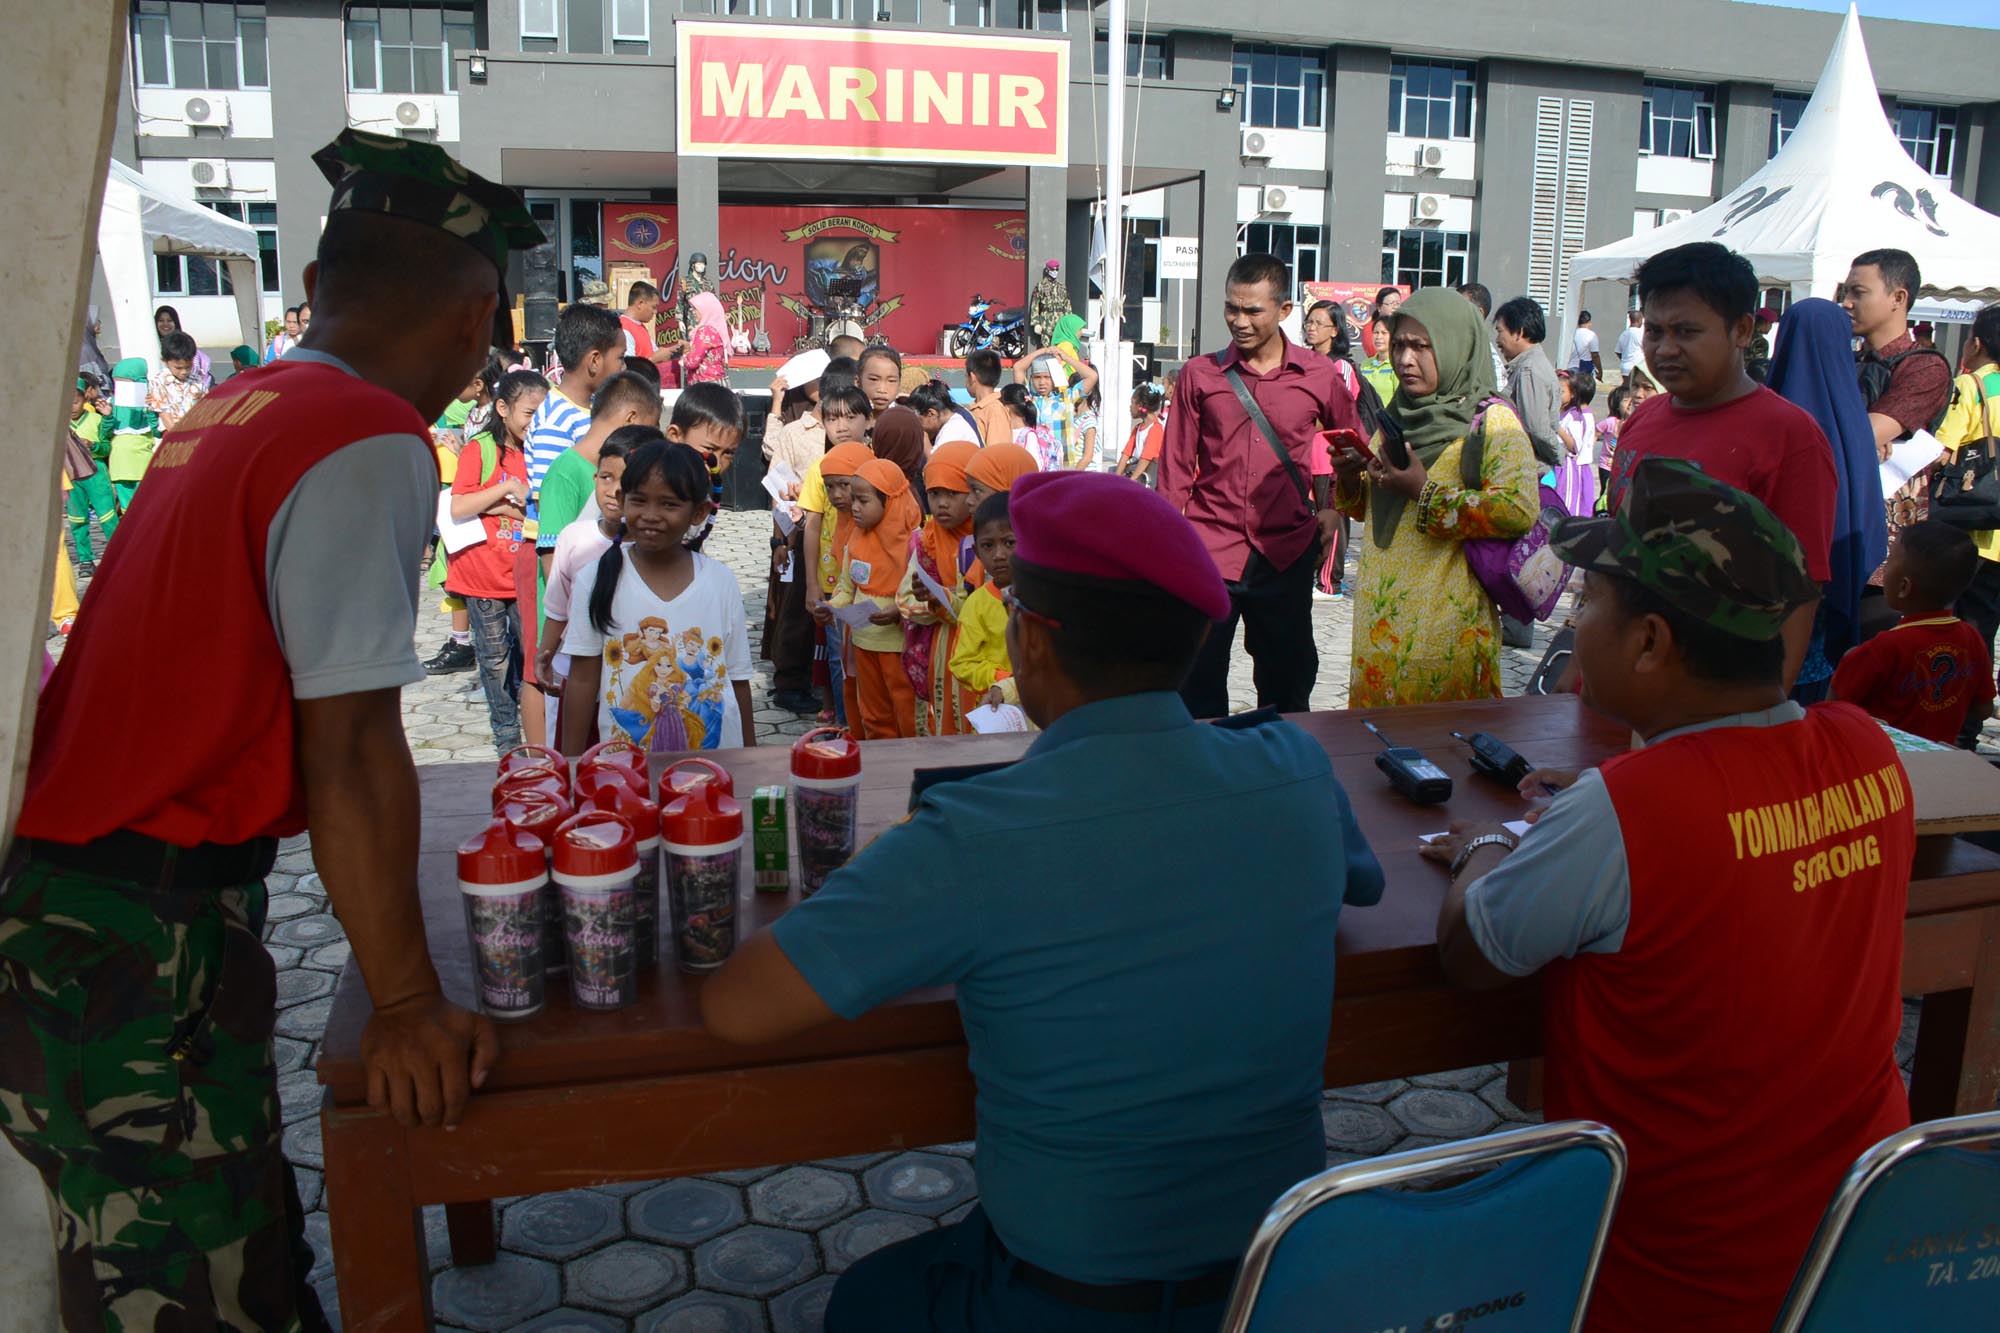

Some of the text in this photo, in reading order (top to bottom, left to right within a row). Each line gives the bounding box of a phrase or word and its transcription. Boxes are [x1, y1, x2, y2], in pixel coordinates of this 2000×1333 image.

[701, 61, 1048, 129] MARINIR
[807, 217, 874, 236] SOLID BERANI KOKOH
[1878, 763, 1906, 814] XIV
[1792, 834, 1882, 893] SORONG
[1424, 1290, 1527, 1333] SORONG
